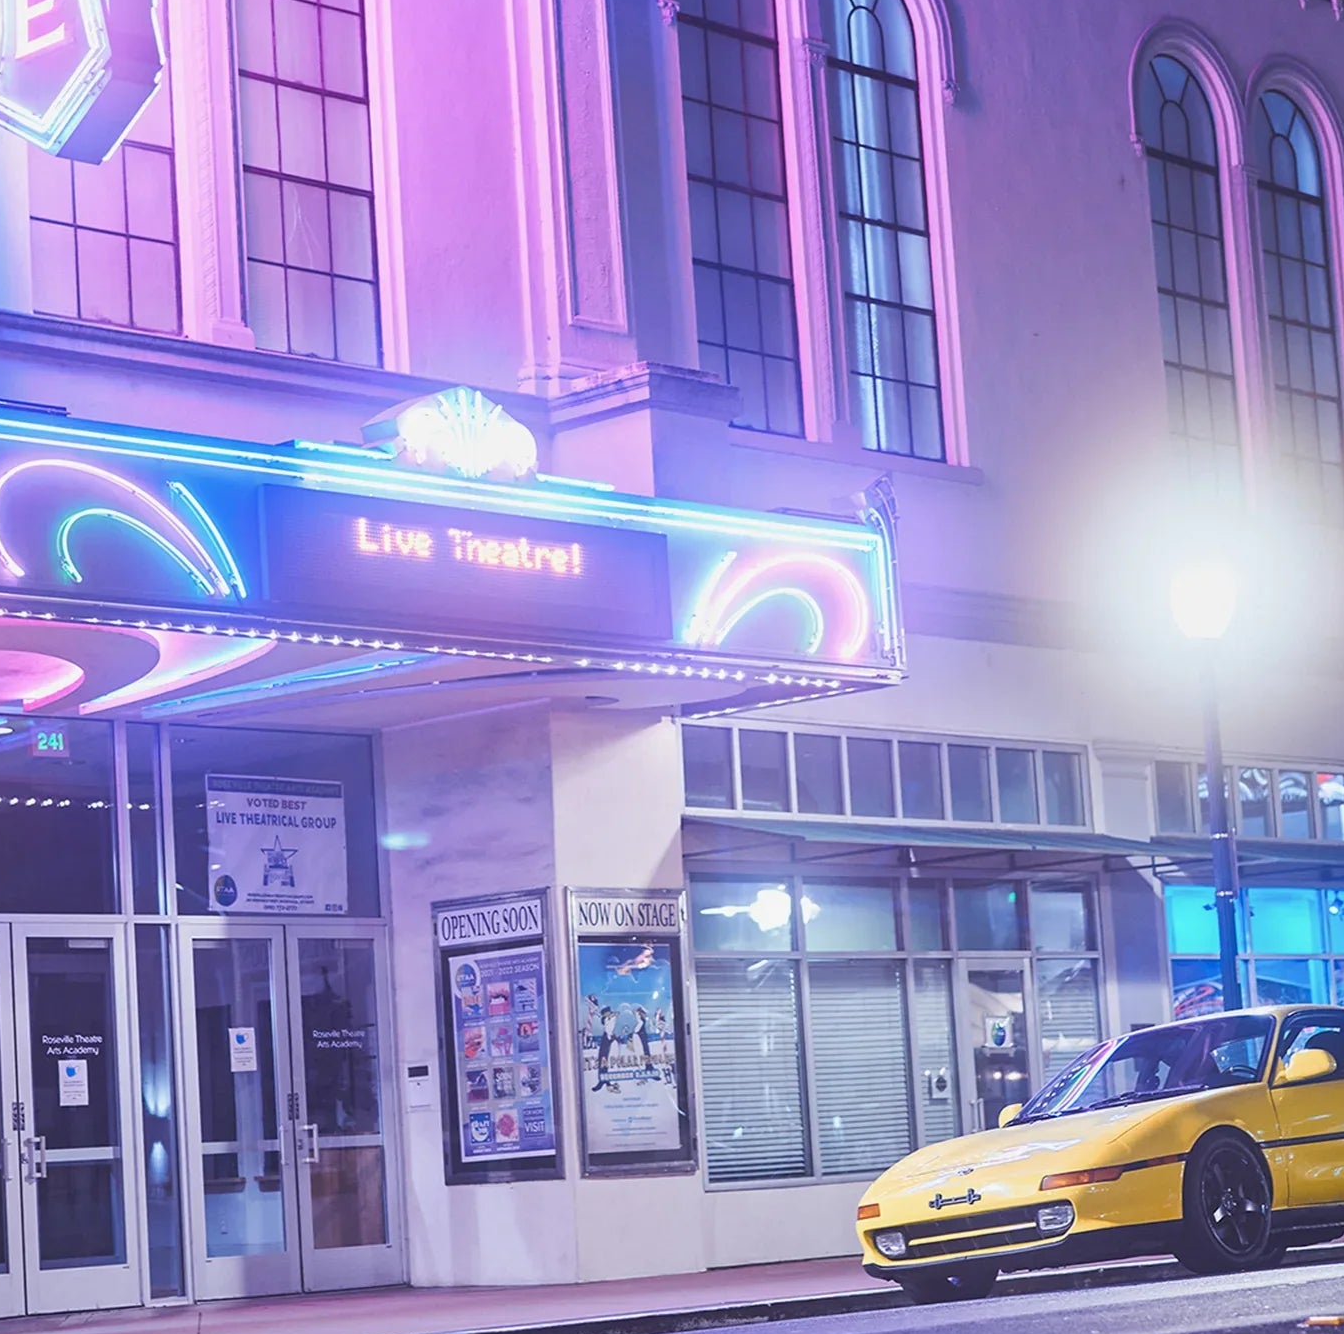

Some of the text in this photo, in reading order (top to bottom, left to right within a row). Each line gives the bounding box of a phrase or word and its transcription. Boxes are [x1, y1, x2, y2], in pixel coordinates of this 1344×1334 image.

[358, 517, 434, 558] Live
[37, 732, 64, 751] 241
[247, 797, 307, 811] VOTED BEST
[216, 811, 337, 829] LIVE THEATRICAL GROUP
[579, 902, 676, 927] NOW ON STAGE
[441, 904, 539, 941] OPENING SOON
[514, 962, 539, 973] SEASON
[42, 1034, 103, 1044] Roseville Theatre
[313, 1029, 366, 1038] Roseville Theatre
[330, 1040, 362, 1049] Academy
[47, 1046, 99, 1056] Arts Academy
[524, 1121, 545, 1132] VISIT
